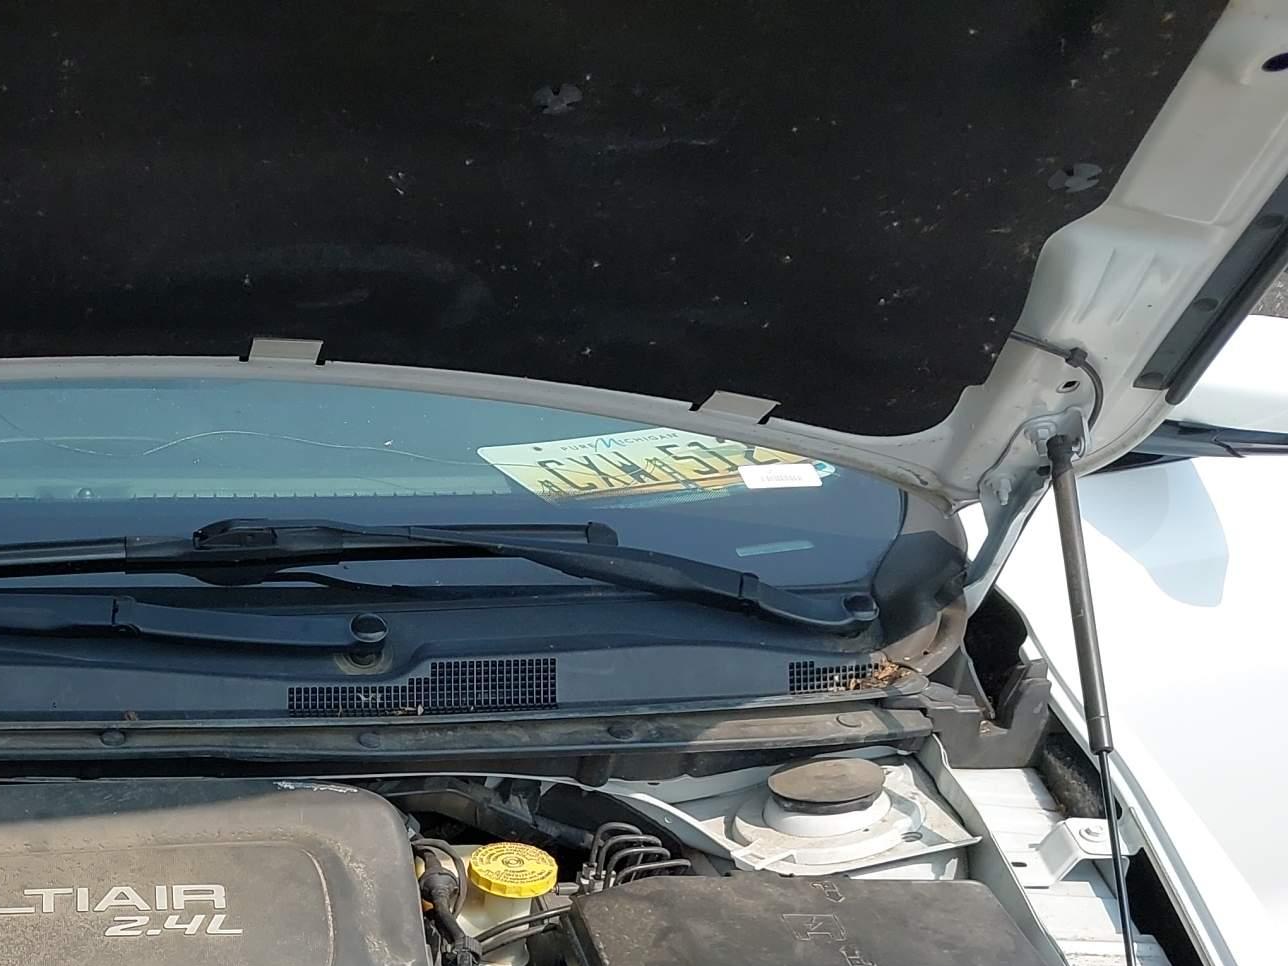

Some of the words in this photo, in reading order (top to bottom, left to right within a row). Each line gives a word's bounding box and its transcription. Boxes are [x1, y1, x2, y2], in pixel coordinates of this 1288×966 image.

[560, 442, 596, 453] PURE
[594, 433, 679, 453] MICHIGAN
[538, 451, 662, 491] CXW
[103, 914, 244, 938] 2.4L
